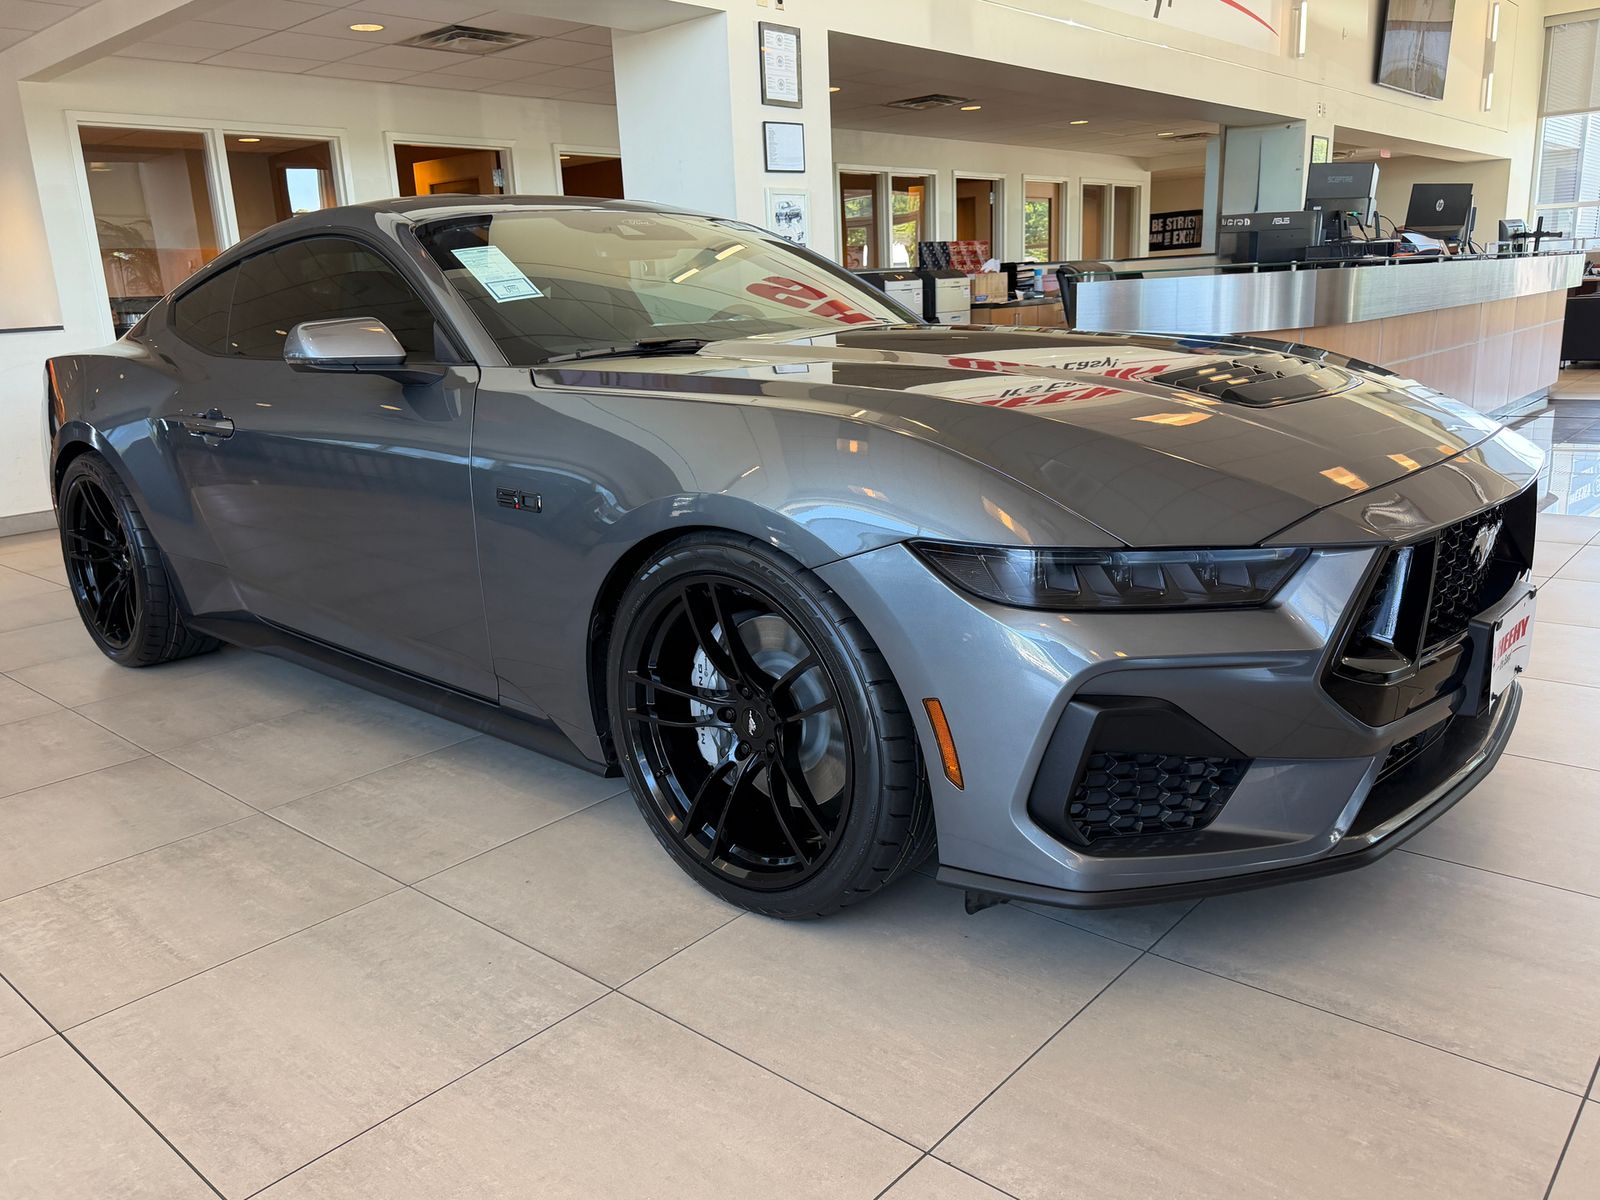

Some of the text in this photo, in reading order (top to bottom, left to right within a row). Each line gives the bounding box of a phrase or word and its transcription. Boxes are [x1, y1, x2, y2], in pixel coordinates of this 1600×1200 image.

[1151, 218, 1164, 232] BE
[1271, 216, 1290, 225] ASUS
[495, 486, 543, 514] 5.0
